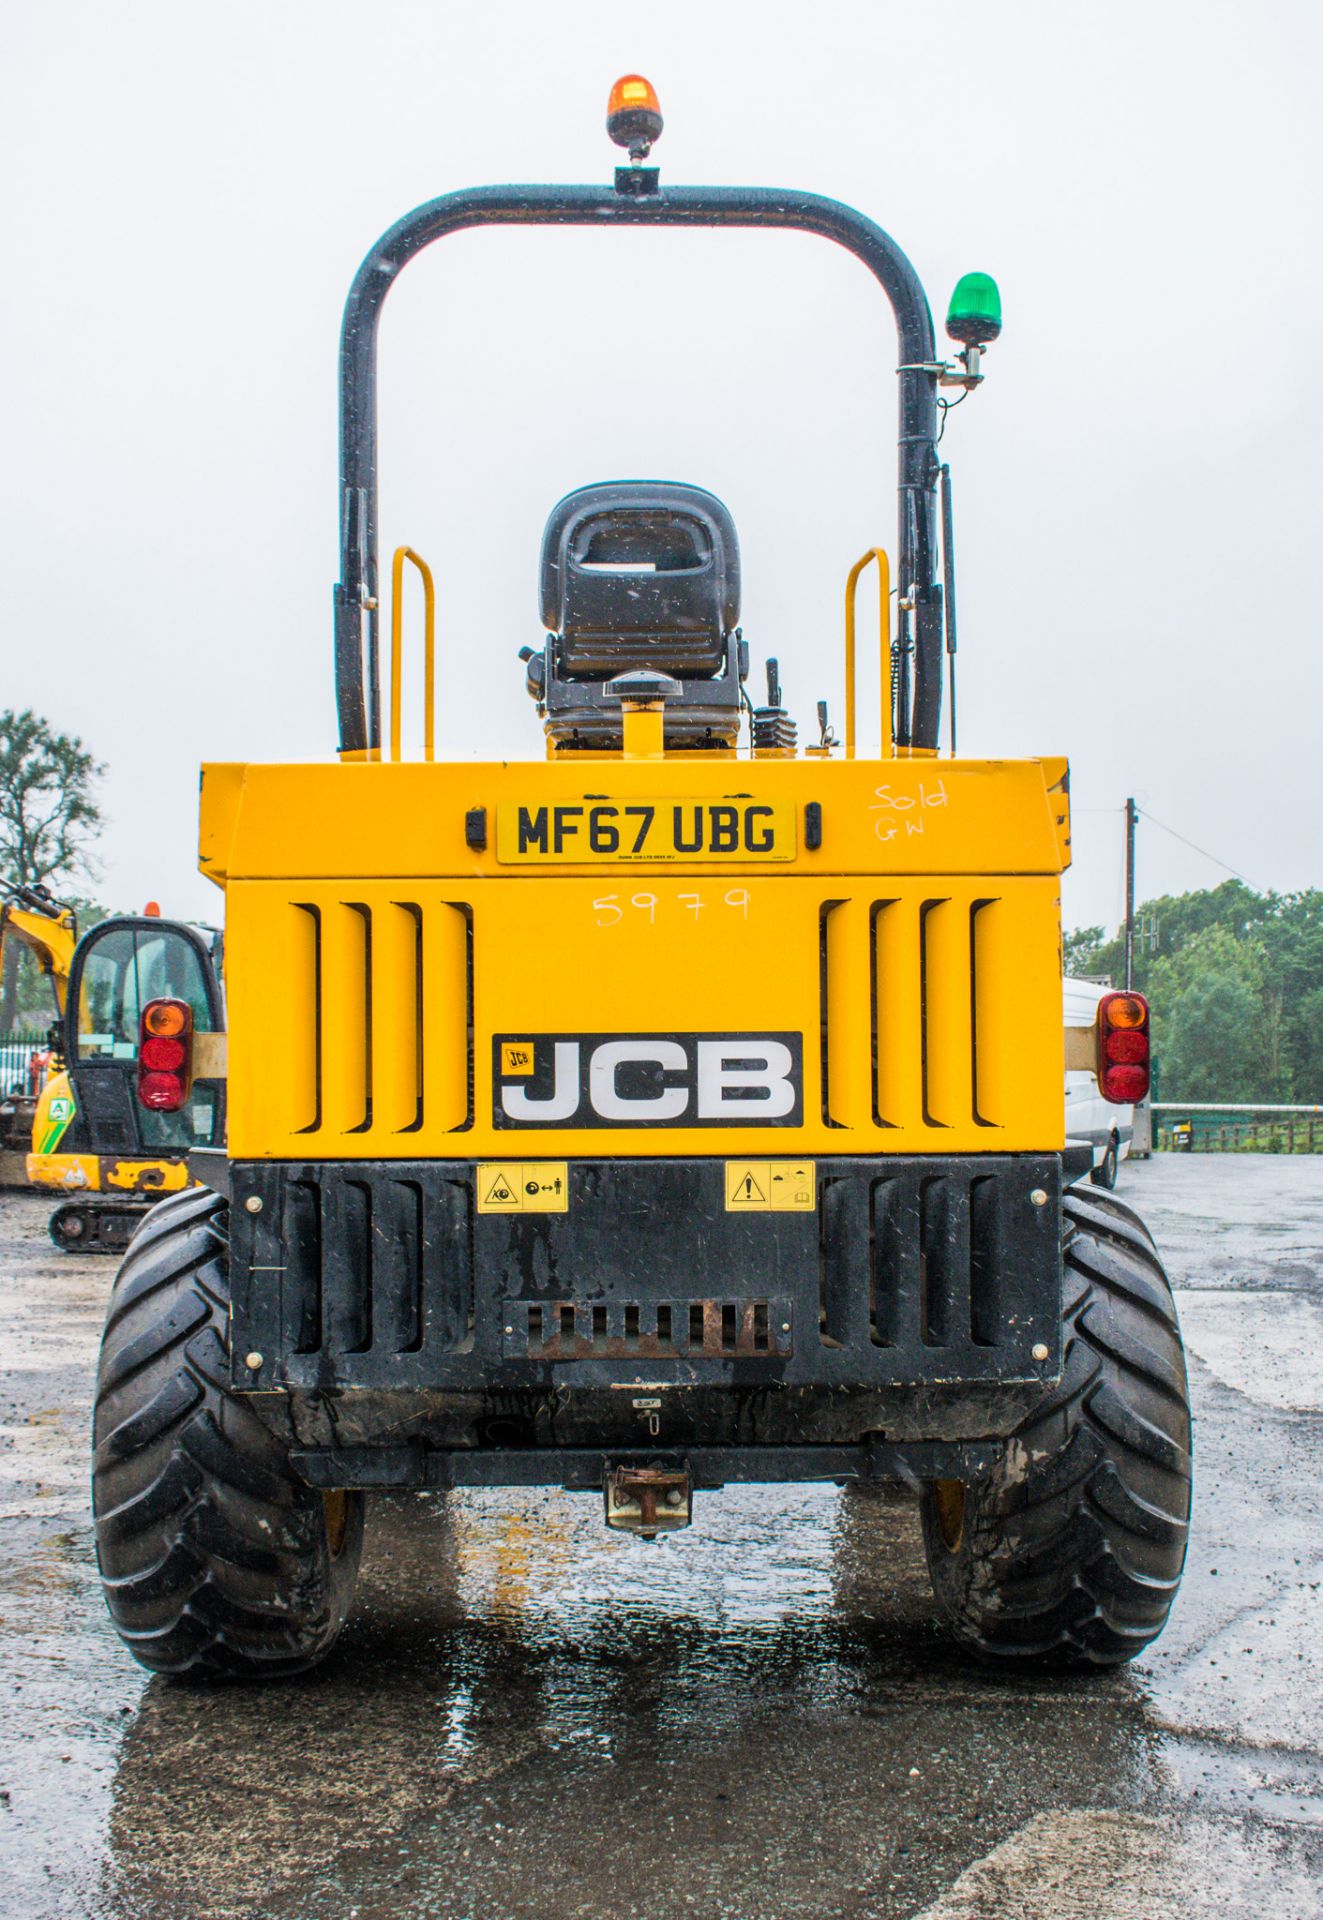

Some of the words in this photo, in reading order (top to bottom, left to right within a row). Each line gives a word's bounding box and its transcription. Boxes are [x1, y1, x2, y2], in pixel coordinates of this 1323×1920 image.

[868, 779, 948, 810] Sold
[517, 806, 655, 854] MF67
[673, 805, 775, 853] UBG
[592, 888, 751, 927] 5979
[510, 1051, 529, 1067] JCB
[501, 1040, 796, 1121] JCB
